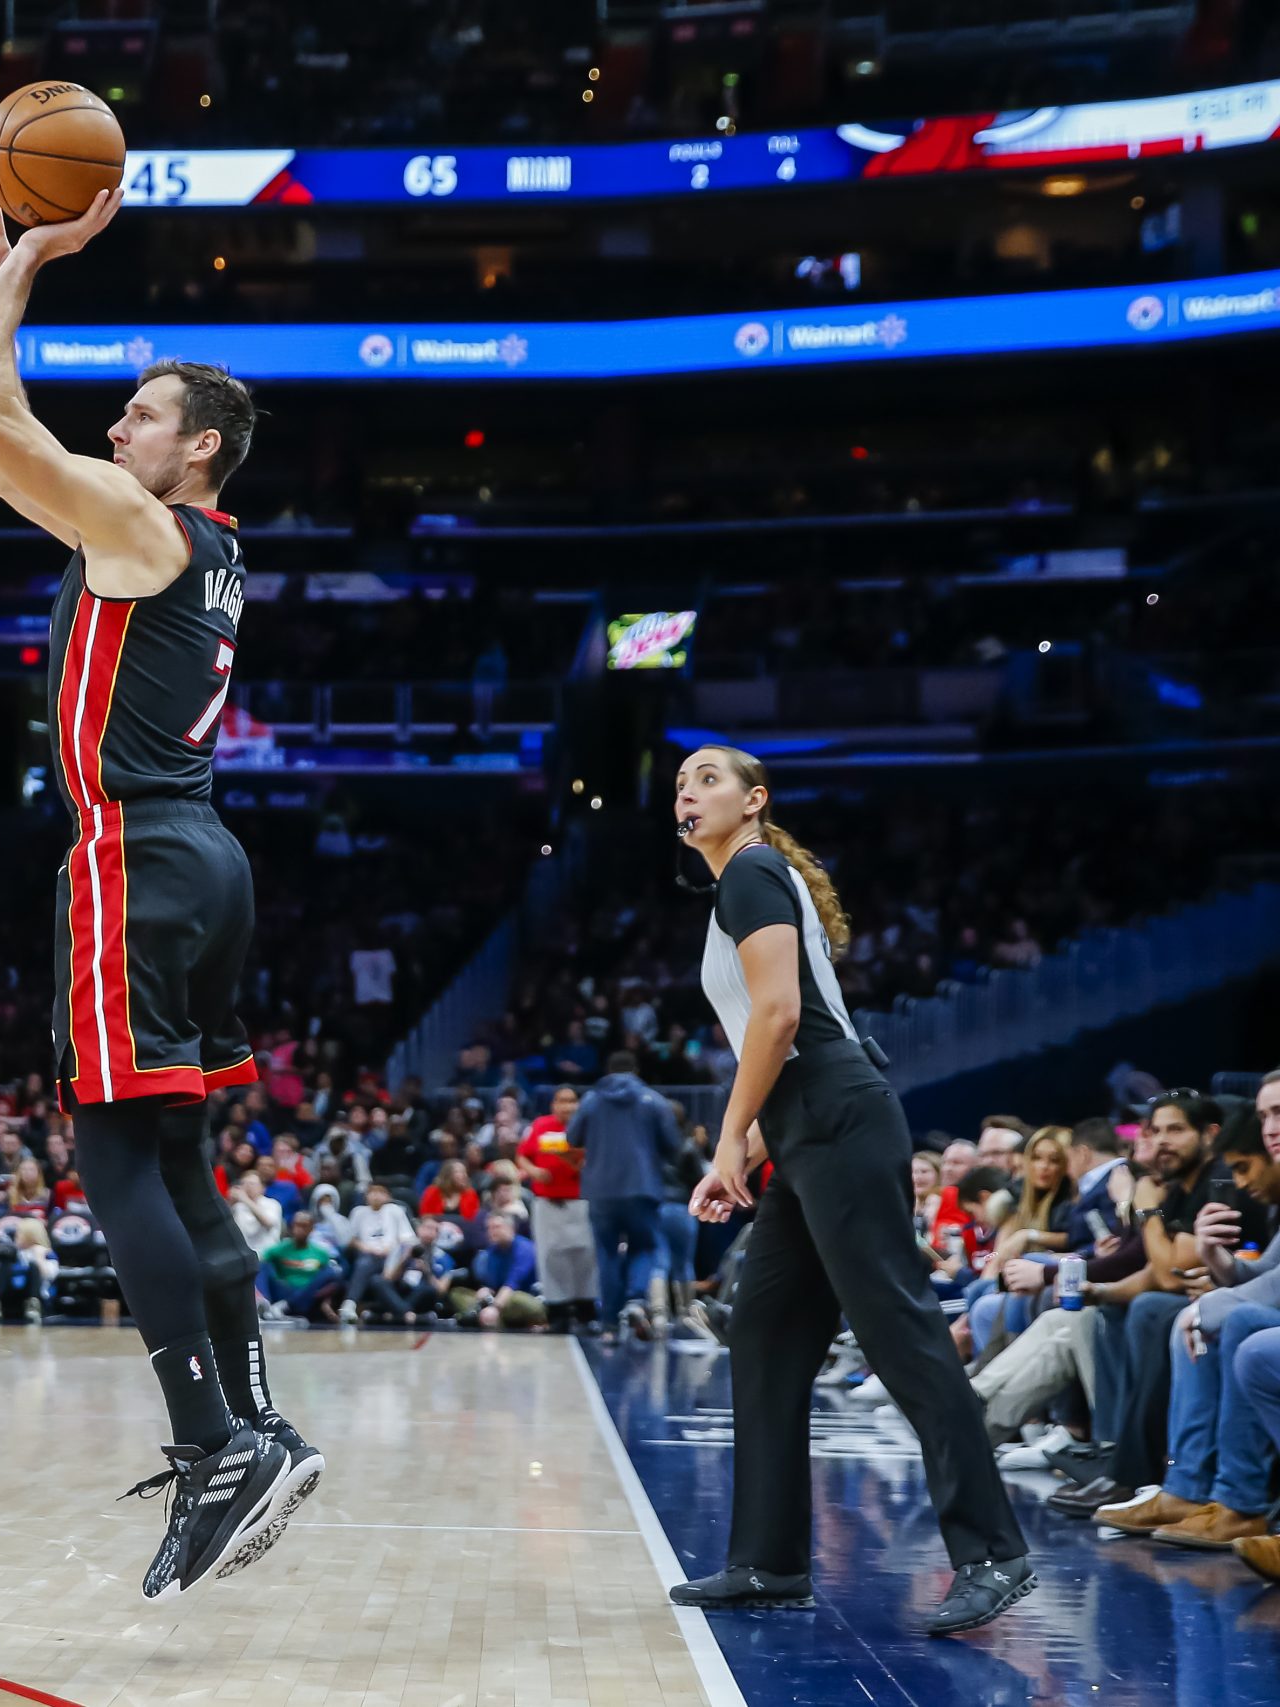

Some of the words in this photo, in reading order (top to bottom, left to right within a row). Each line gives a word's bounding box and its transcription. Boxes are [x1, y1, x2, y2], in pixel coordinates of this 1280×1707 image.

[130, 159, 191, 205] 45
[403, 155, 457, 196] 65
[41, 339, 126, 363] Walmart
[411, 339, 501, 363] Walmart
[787, 322, 880, 349] Walmart
[183, 637, 237, 748] 7
